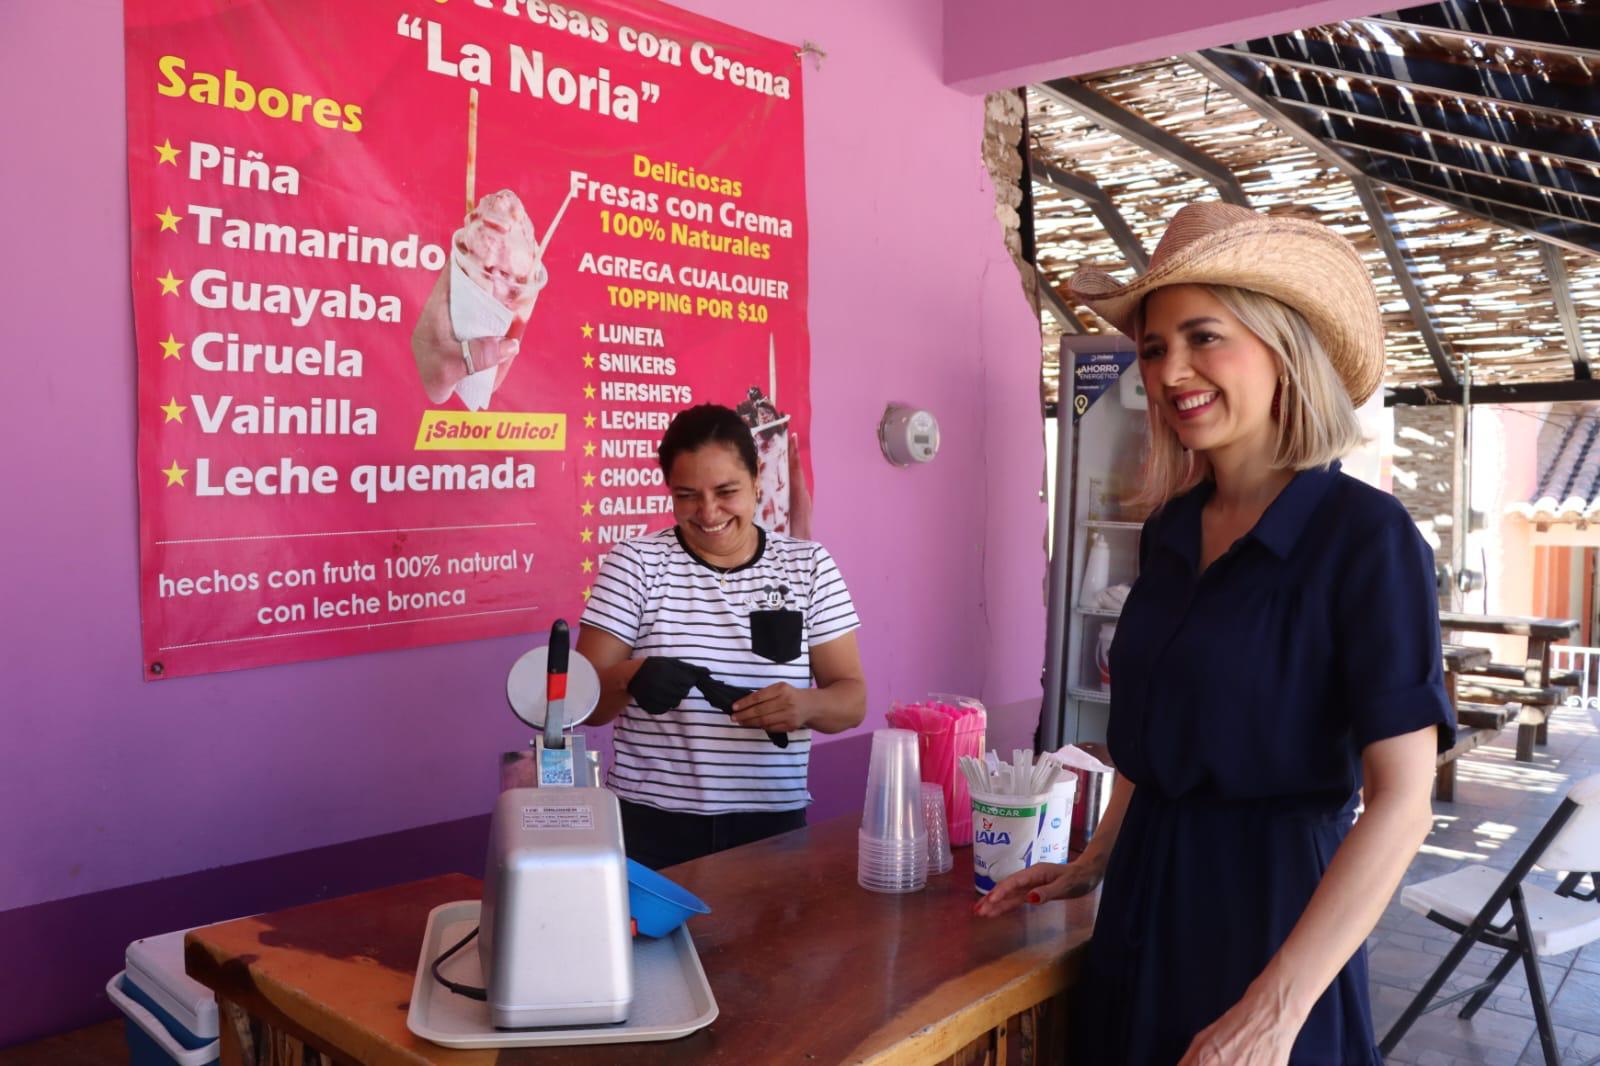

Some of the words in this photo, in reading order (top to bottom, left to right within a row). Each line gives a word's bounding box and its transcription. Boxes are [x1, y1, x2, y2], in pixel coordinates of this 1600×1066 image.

[473, 0, 609, 43] resas
[618, 26, 682, 67] con
[690, 41, 791, 100] Crema
[157, 55, 363, 132] Sabores
[189, 141, 300, 196] Piña
[633, 154, 742, 198] Deliciosas
[569, 170, 659, 213] Fresas
[665, 196, 713, 224] con
[719, 202, 793, 239] Crema
[187, 205, 446, 271] Tamarindo
[600, 210, 666, 243] 100%
[671, 222, 771, 261] Naturales
[189, 268, 402, 328] Guayaba
[578, 252, 675, 286] AGREGA
[679, 266, 789, 300] CUALQUIER
[607, 285, 692, 315] TOPPING
[696, 296, 733, 320] POR
[737, 301, 769, 324] $10
[191, 331, 363, 377] Ciruela
[598, 323, 665, 348] LUNETA
[599, 352, 677, 376] SNIKERS
[190, 394, 378, 436] Vainilla
[600, 381, 692, 404] HERSHEYS
[425, 420, 492, 442] ¡Sabor
[496, 422, 558, 440] Unico!
[195, 457, 338, 497] Leche
[350, 457, 537, 504] quemada
[598, 524, 648, 545] NUEZ
[158, 569, 260, 598] hechos
[267, 567, 316, 589] con
[322, 561, 376, 584] fruta
[383, 554, 442, 580] 100%
[447, 549, 518, 575] natural
[522, 552, 535, 573] y
[257, 605, 305, 625] con
[313, 593, 380, 619] leche
[388, 587, 466, 612] bronca
[975, 831, 1011, 846] LALA
